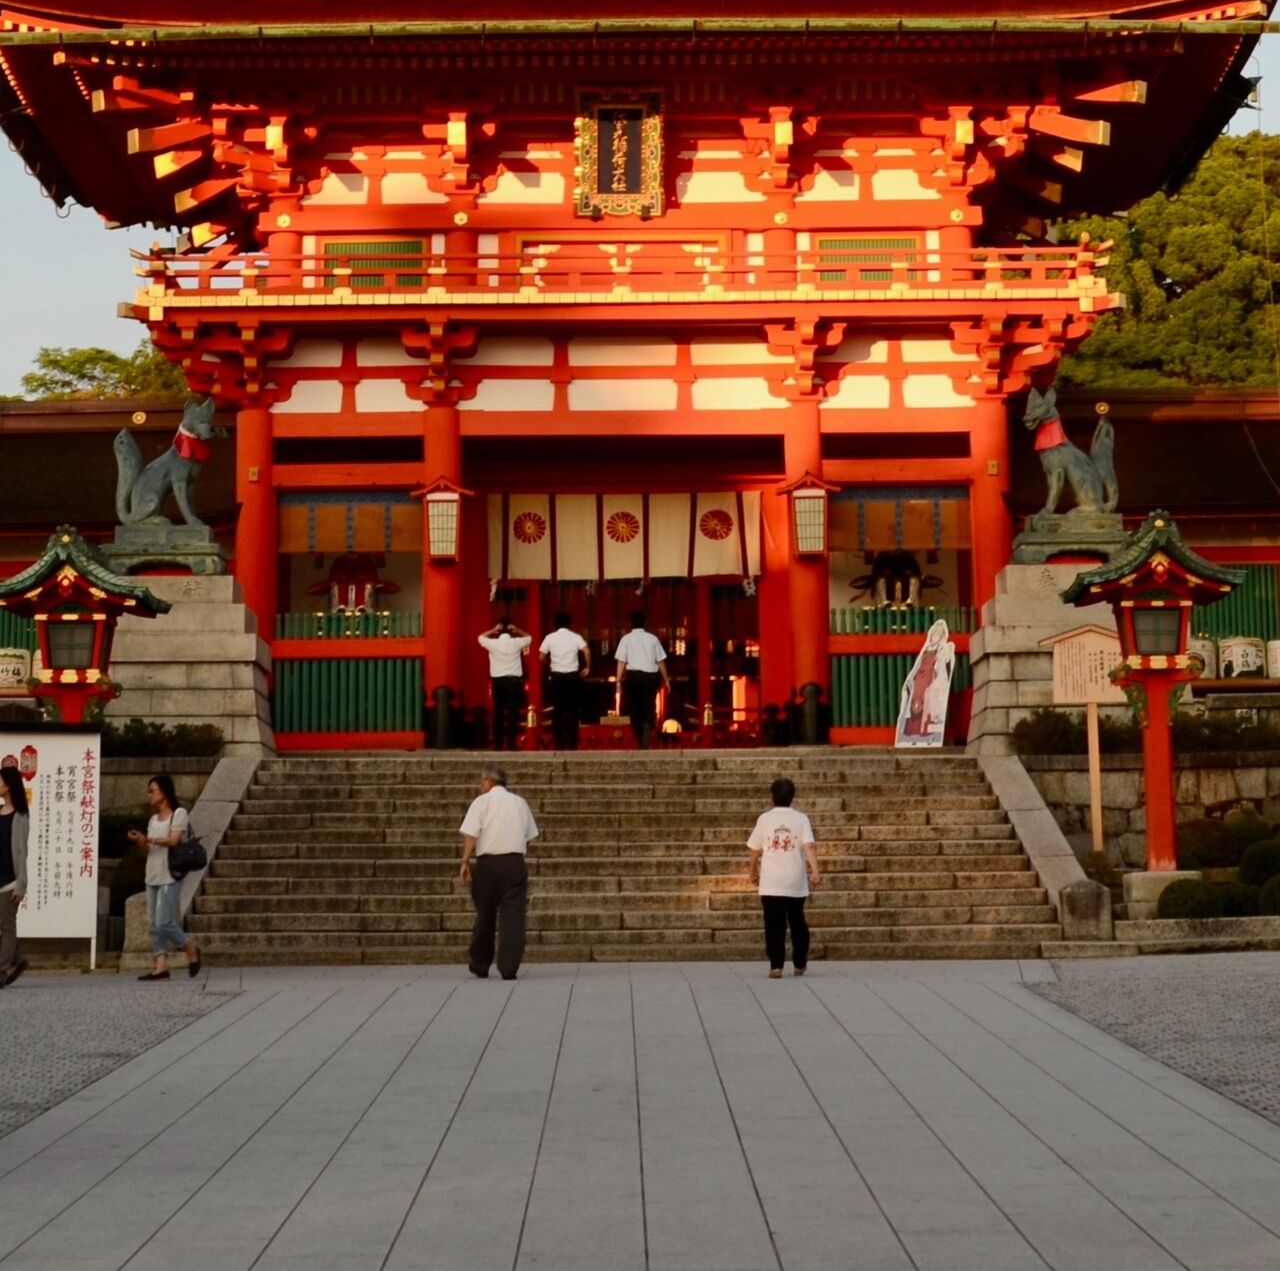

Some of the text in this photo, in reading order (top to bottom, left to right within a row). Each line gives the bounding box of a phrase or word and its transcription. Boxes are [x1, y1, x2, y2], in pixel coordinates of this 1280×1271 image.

[54, 764, 65, 804] 本宮祭
[79, 747, 97, 878] 本宮祭献灯のご案内
